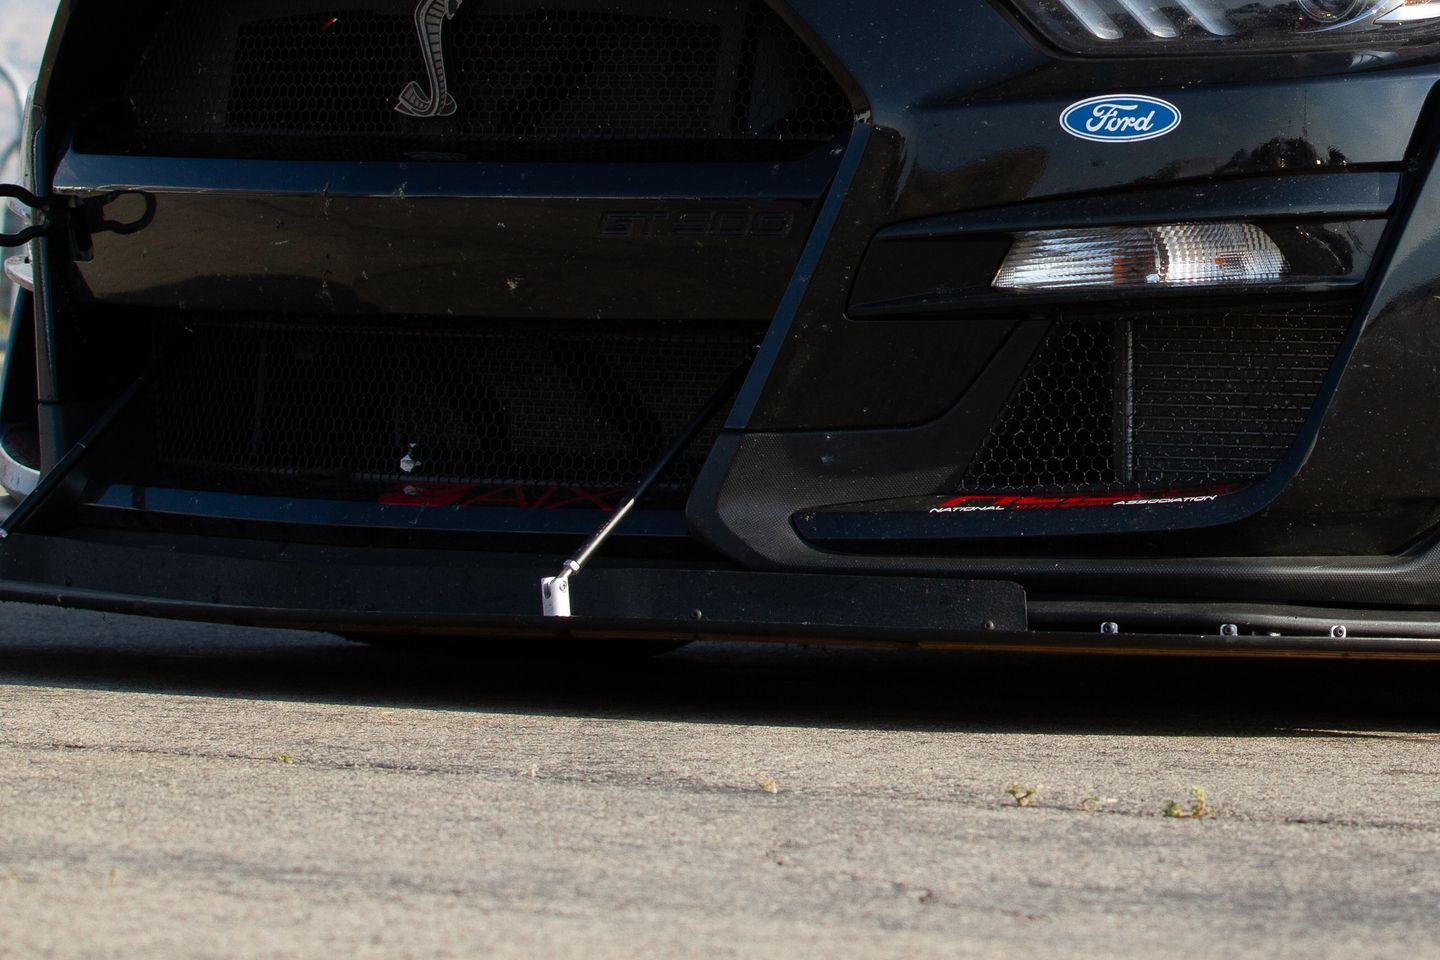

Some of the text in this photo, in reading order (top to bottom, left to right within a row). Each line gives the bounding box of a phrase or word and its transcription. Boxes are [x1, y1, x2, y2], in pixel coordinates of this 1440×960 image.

[1085, 103, 1156, 132] Ford
[1112, 494, 1218, 506] ASSOCIATION
[928, 505, 1005, 514] NATIONAL
